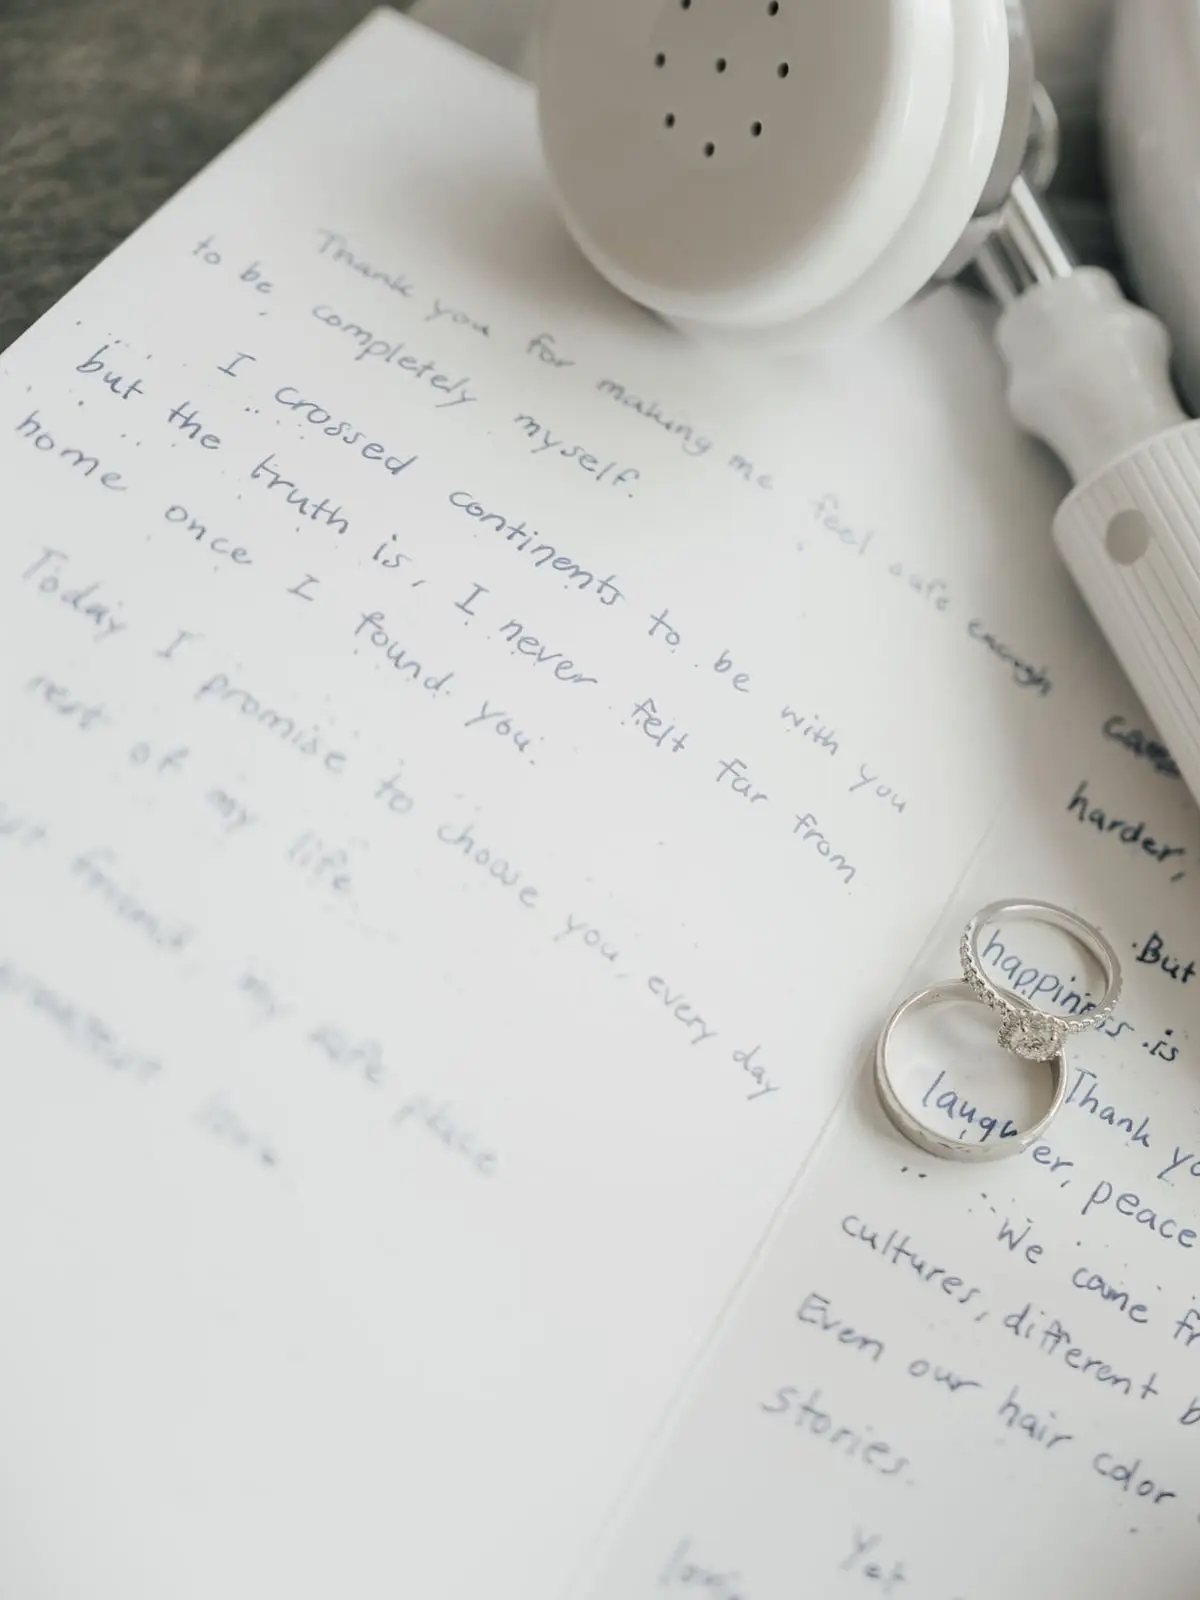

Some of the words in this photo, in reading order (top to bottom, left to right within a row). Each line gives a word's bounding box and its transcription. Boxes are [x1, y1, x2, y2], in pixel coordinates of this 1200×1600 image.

[192, 234, 222, 266] to
[239, 261, 273, 295] be
[311, 303, 477, 408] completely
[317, 228, 412, 299] Thank
[425, 298, 490, 338] you
[525, 333, 576, 371] for
[597, 377, 713, 456] making
[728, 453, 773, 490] me
[812, 493, 875, 556] feel
[15, 410, 129, 494] home
[164, 504, 253, 567] once
[287, 574, 319, 601] I
[217, 352, 256, 378] I
[275, 386, 418, 476] crossed
[449, 491, 626, 606] continents
[648, 609, 682, 647] to
[713, 649, 751, 693] be
[780, 704, 840, 756] with
[849, 764, 907, 814] you
[75, 344, 144, 402] but
[168, 401, 221, 451] the
[251, 453, 349, 534] truth
[455, 582, 489, 615] I
[500, 618, 597, 684] never
[631, 697, 686, 753] felt
[793, 812, 856, 884] from
[22, 546, 127, 641] Today
[155, 628, 202, 660] I
[196, 673, 347, 773] promise
[374, 770, 414, 814] to
[436, 821, 540, 908] choose
[646, 972, 718, 1046] every
[731, 1045, 780, 1101] day
[1136, 930, 1196, 983] But
[1065, 1067, 1151, 1148] Thank
[1149, 1029, 1180, 1062] is
[996, 1217, 1043, 1264] We
[1073, 1265, 1149, 1324] came
[1082, 1180, 1198, 1249] peace
[796, 1293, 884, 1361] Even
[908, 1356, 983, 1393] our
[998, 1392, 1073, 1450] hair
[1092, 1448, 1177, 1505] color
[1004, 1304, 1158, 1398] different
